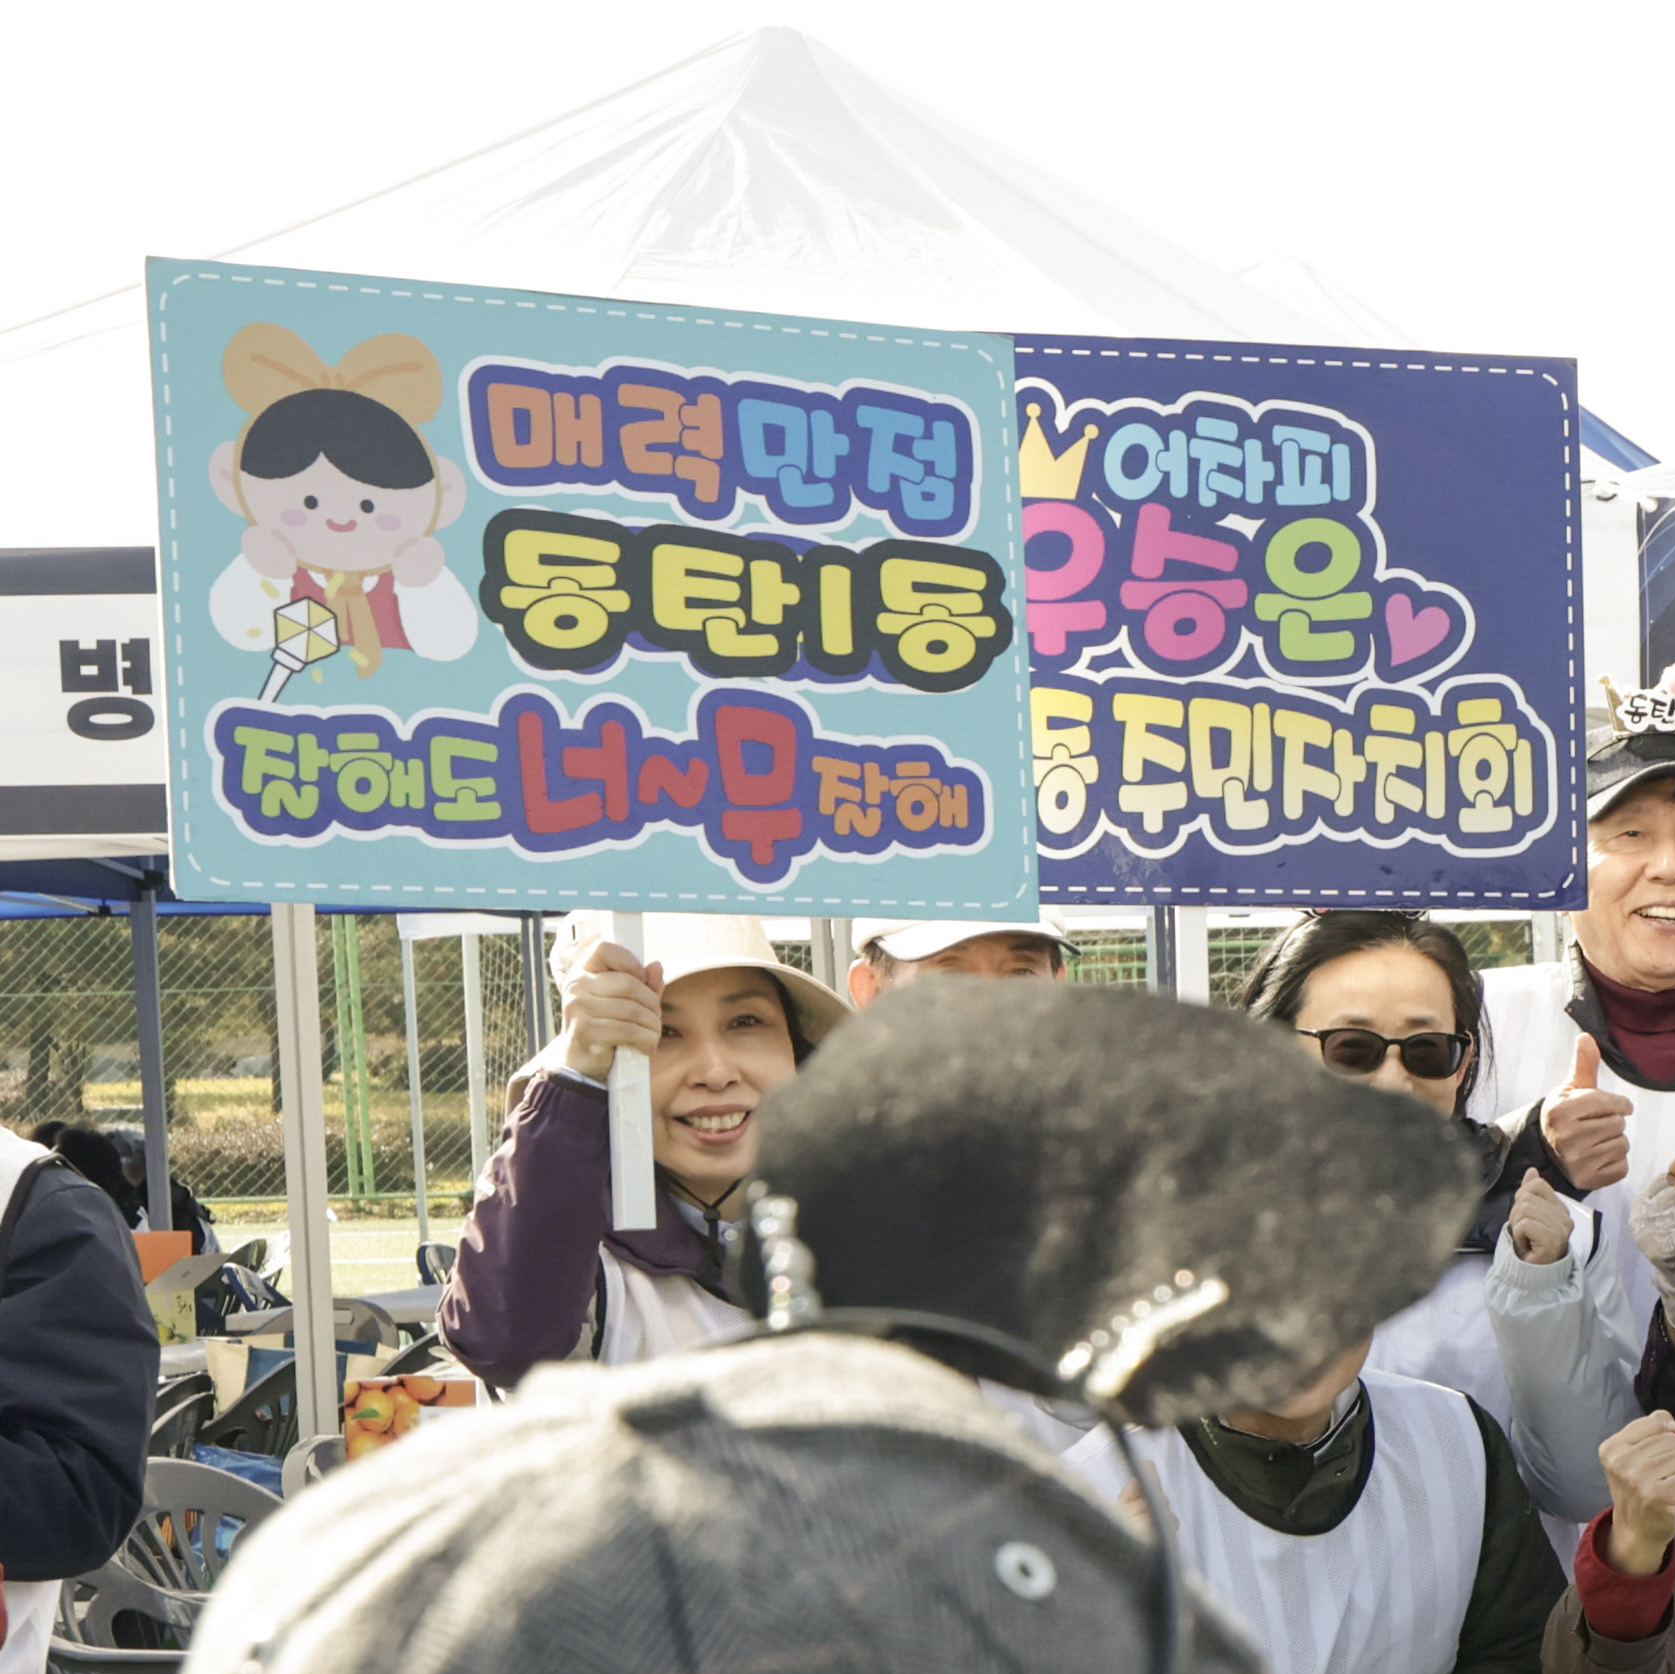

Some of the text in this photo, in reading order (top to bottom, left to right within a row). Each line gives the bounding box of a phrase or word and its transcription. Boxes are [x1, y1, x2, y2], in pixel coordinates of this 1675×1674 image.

[1103, 416, 1351, 508] 어차피
[1020, 502, 1373, 662] 우승은
[59, 637, 155, 741] 병
[233, 725, 502, 823] 잘해도
[811, 757, 970, 838] 잘해
[1112, 692, 1532, 835] 주민자치회
